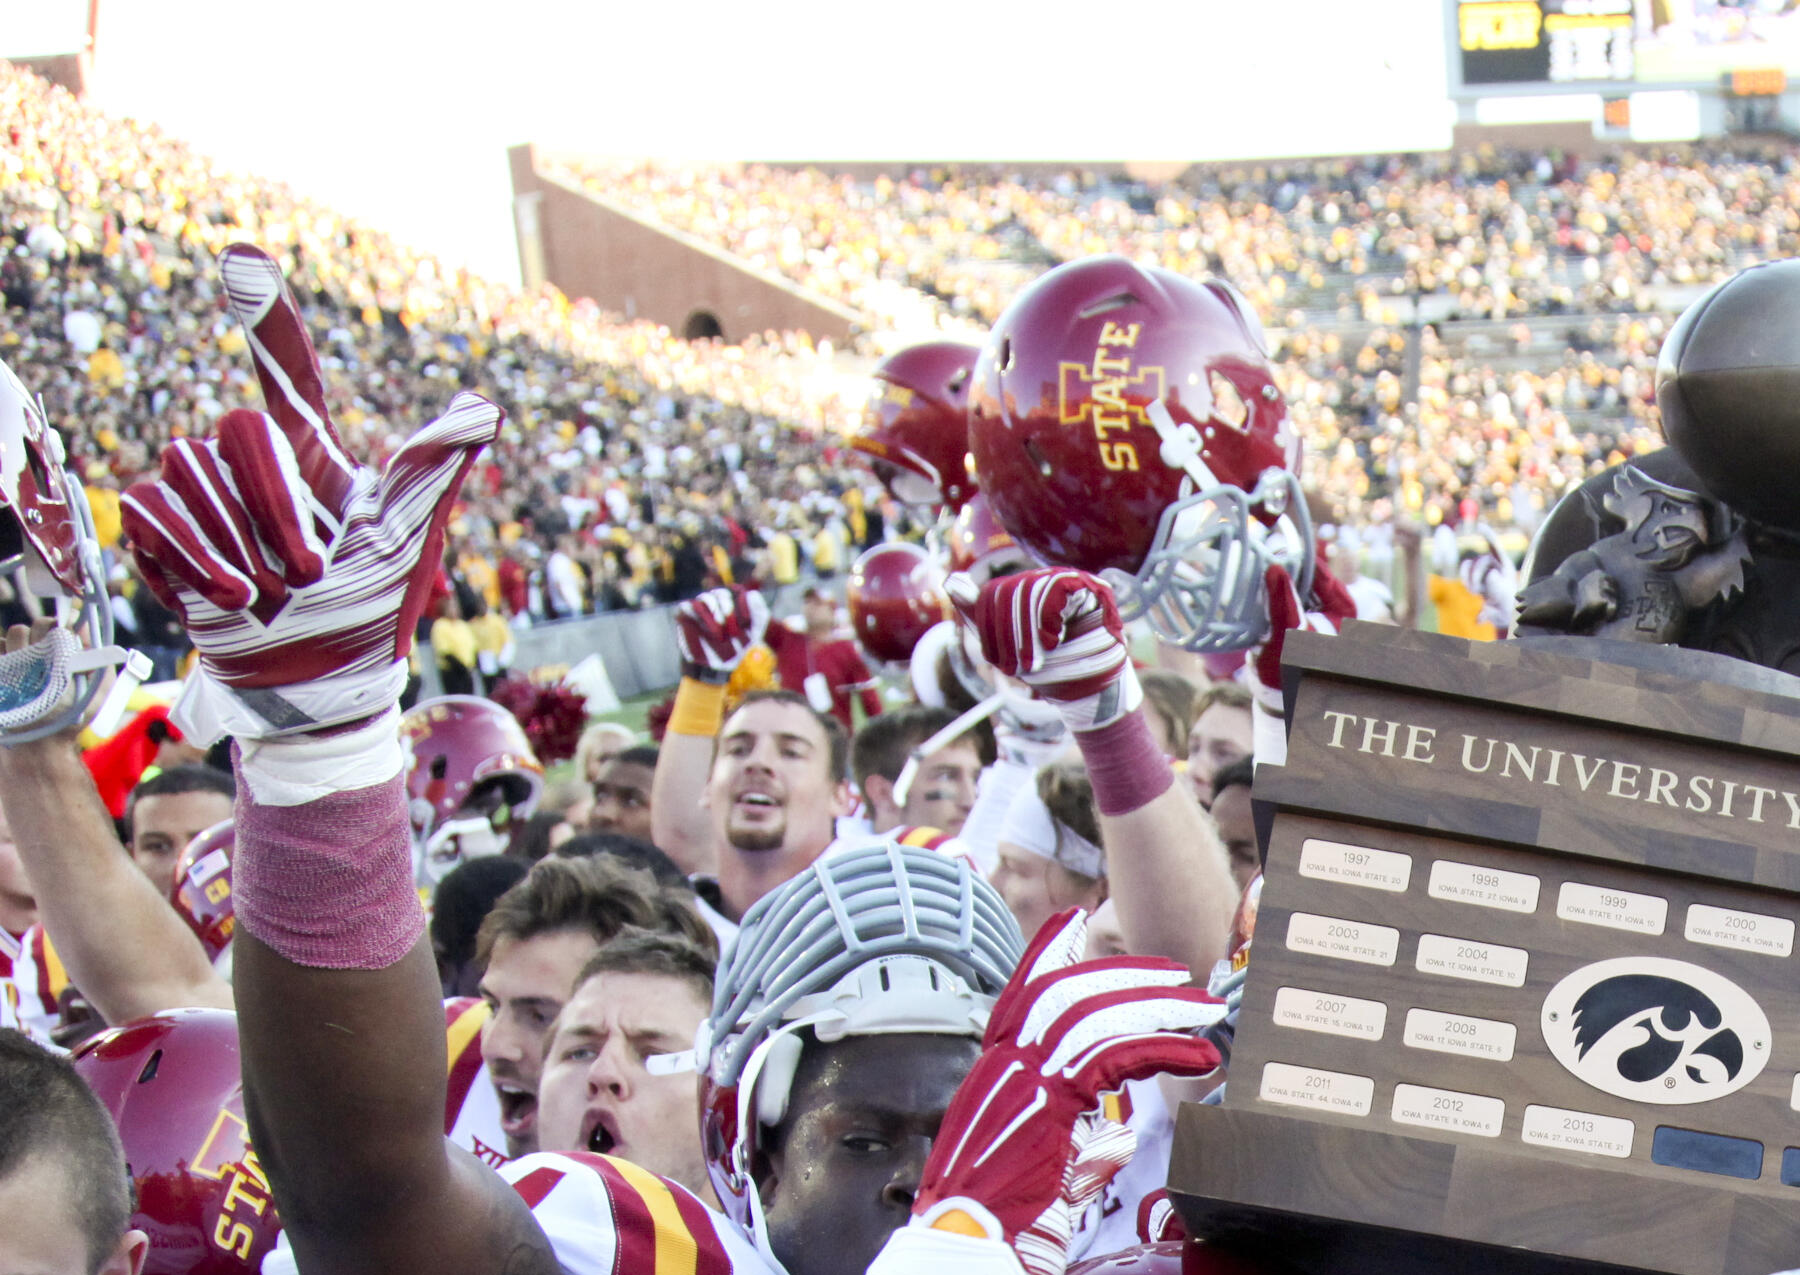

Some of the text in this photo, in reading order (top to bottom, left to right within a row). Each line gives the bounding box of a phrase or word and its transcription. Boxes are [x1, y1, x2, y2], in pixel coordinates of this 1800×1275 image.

[1091, 320, 1145, 473] STATE
[1323, 710, 1438, 764] THE
[1344, 852, 1371, 868] 1997
[1306, 863, 1326, 873] IOWA
[1341, 869, 1362, 879] IOWA
[1364, 873, 1388, 883] STATE
[1472, 873, 1500, 888] 1998
[1437, 885, 1458, 895] IOWA
[1459, 888, 1484, 899] STATE
[1498, 895, 1518, 905] IOWA
[1601, 895, 1628, 911] 1999
[1566, 905, 1586, 915] IOWA
[1588, 909, 1612, 920] STATE
[1624, 915, 1644, 926] IOWA
[1725, 916, 1757, 932] 2000
[1328, 925, 1360, 941] 2003
[1692, 927, 1712, 937] IOWA
[1713, 931, 1738, 941] STATE
[1753, 938, 1776, 948] IOWA
[1294, 936, 1314, 946] IOWA
[1329, 942, 1350, 952] IOWA
[1352, 946, 1376, 957] STATE
[1457, 947, 1488, 963] 2004
[1425, 958, 1446, 968] IOWA
[1457, 963, 1480, 974] IOWA
[1480, 967, 1504, 978] STATE
[1316, 999, 1347, 1016] 2007
[1281, 1010, 1302, 1020] IOWA
[1304, 1014, 1328, 1025] STATE
[1343, 1021, 1364, 1031] IOWA
[1445, 1021, 1477, 1037] 2008
[1414, 1033, 1434, 1042] IOWA
[1447, 1038, 1466, 1048] IOWA
[1469, 1042, 1494, 1052] STATE
[1305, 1075, 1332, 1091] 2011
[1268, 1086, 1288, 1096] IOWA
[1290, 1090, 1314, 1100] STATE
[1331, 1097, 1352, 1106] IOWA
[1433, 1097, 1464, 1113] 2012
[1402, 1110, 1422, 1119] IOWA
[1425, 1114, 1450, 1123] STATE
[1462, 1120, 1482, 1128] IOWA
[1563, 1118, 1595, 1134] 2013
[1528, 1130, 1548, 1140] IOWA
[1564, 1136, 1584, 1145] IOWA
[1587, 1139, 1612, 1149] STATE
